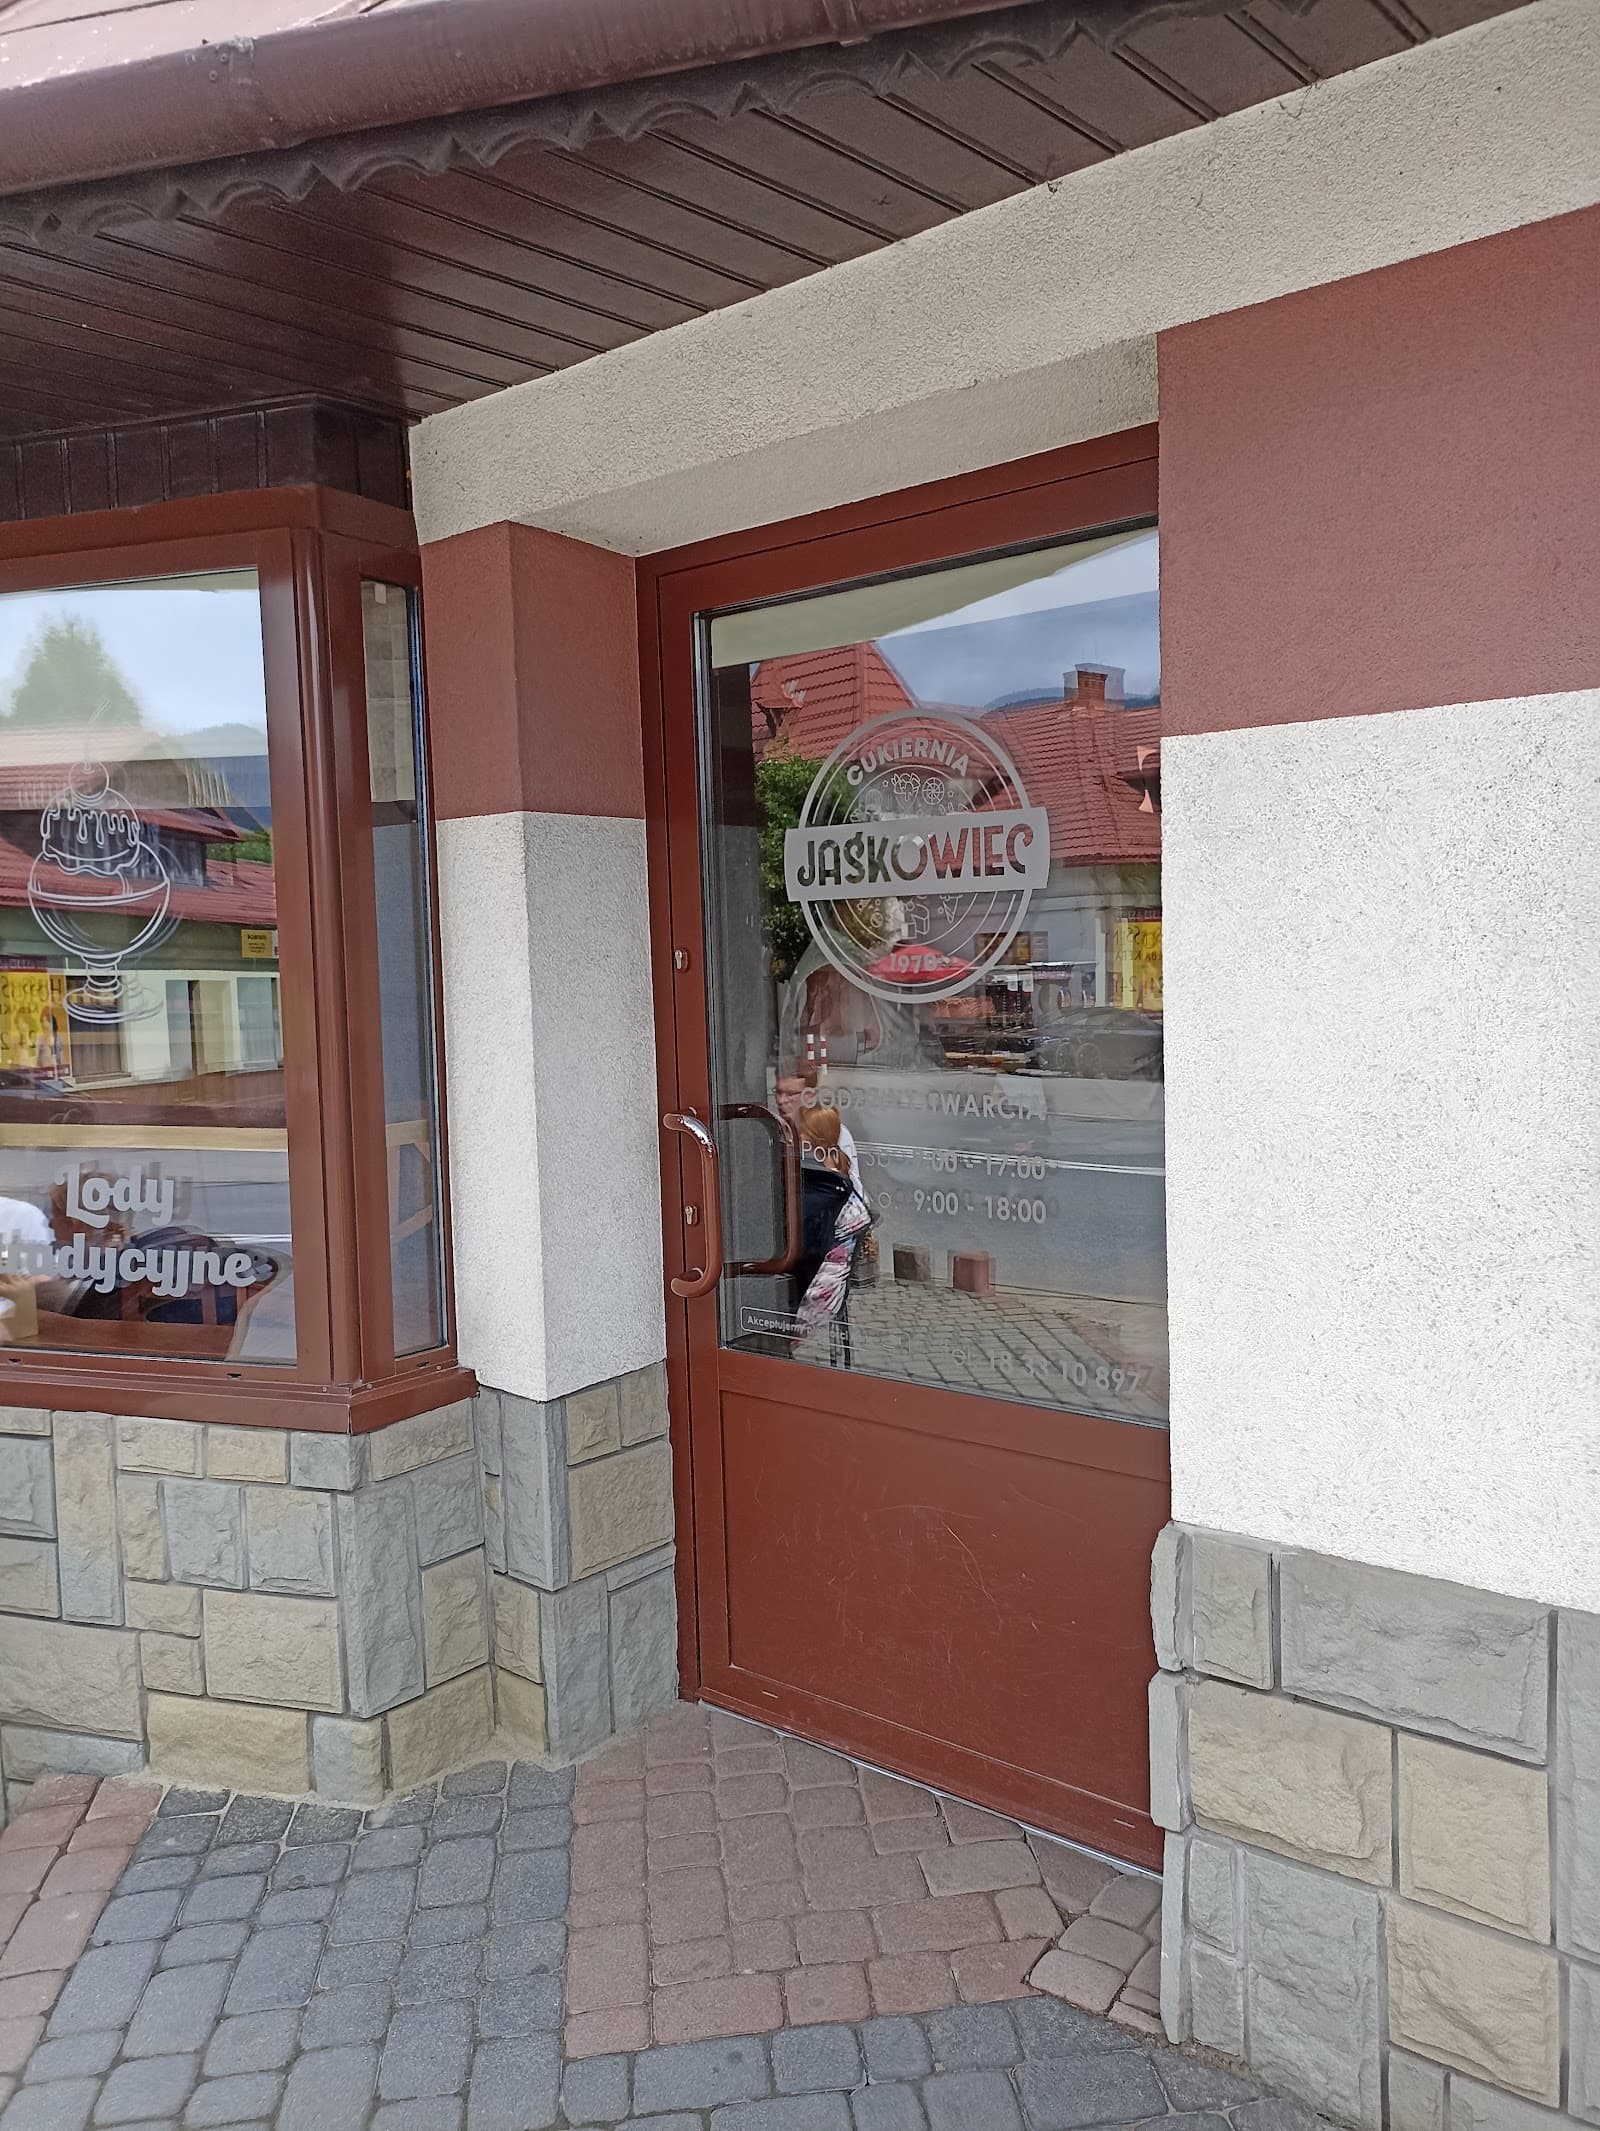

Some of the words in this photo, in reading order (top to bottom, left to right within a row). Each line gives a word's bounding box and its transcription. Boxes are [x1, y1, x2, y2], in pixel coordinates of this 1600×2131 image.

[846, 737, 970, 787] CUKIERNIA
[796, 823, 1034, 888] JAŚKOWIEC
[909, 1091, 1047, 1121] TWARCIA
[984, 1153, 1047, 1181] 17:00
[54, 1161, 176, 1229] Lody
[912, 1187, 959, 1217] 9:00
[984, 1196, 1047, 1225] 18:00
[0, 1230, 257, 1298] radycyjne
[1059, 1359, 1087, 1387] 10
[1095, 1365, 1141, 1394] 897
